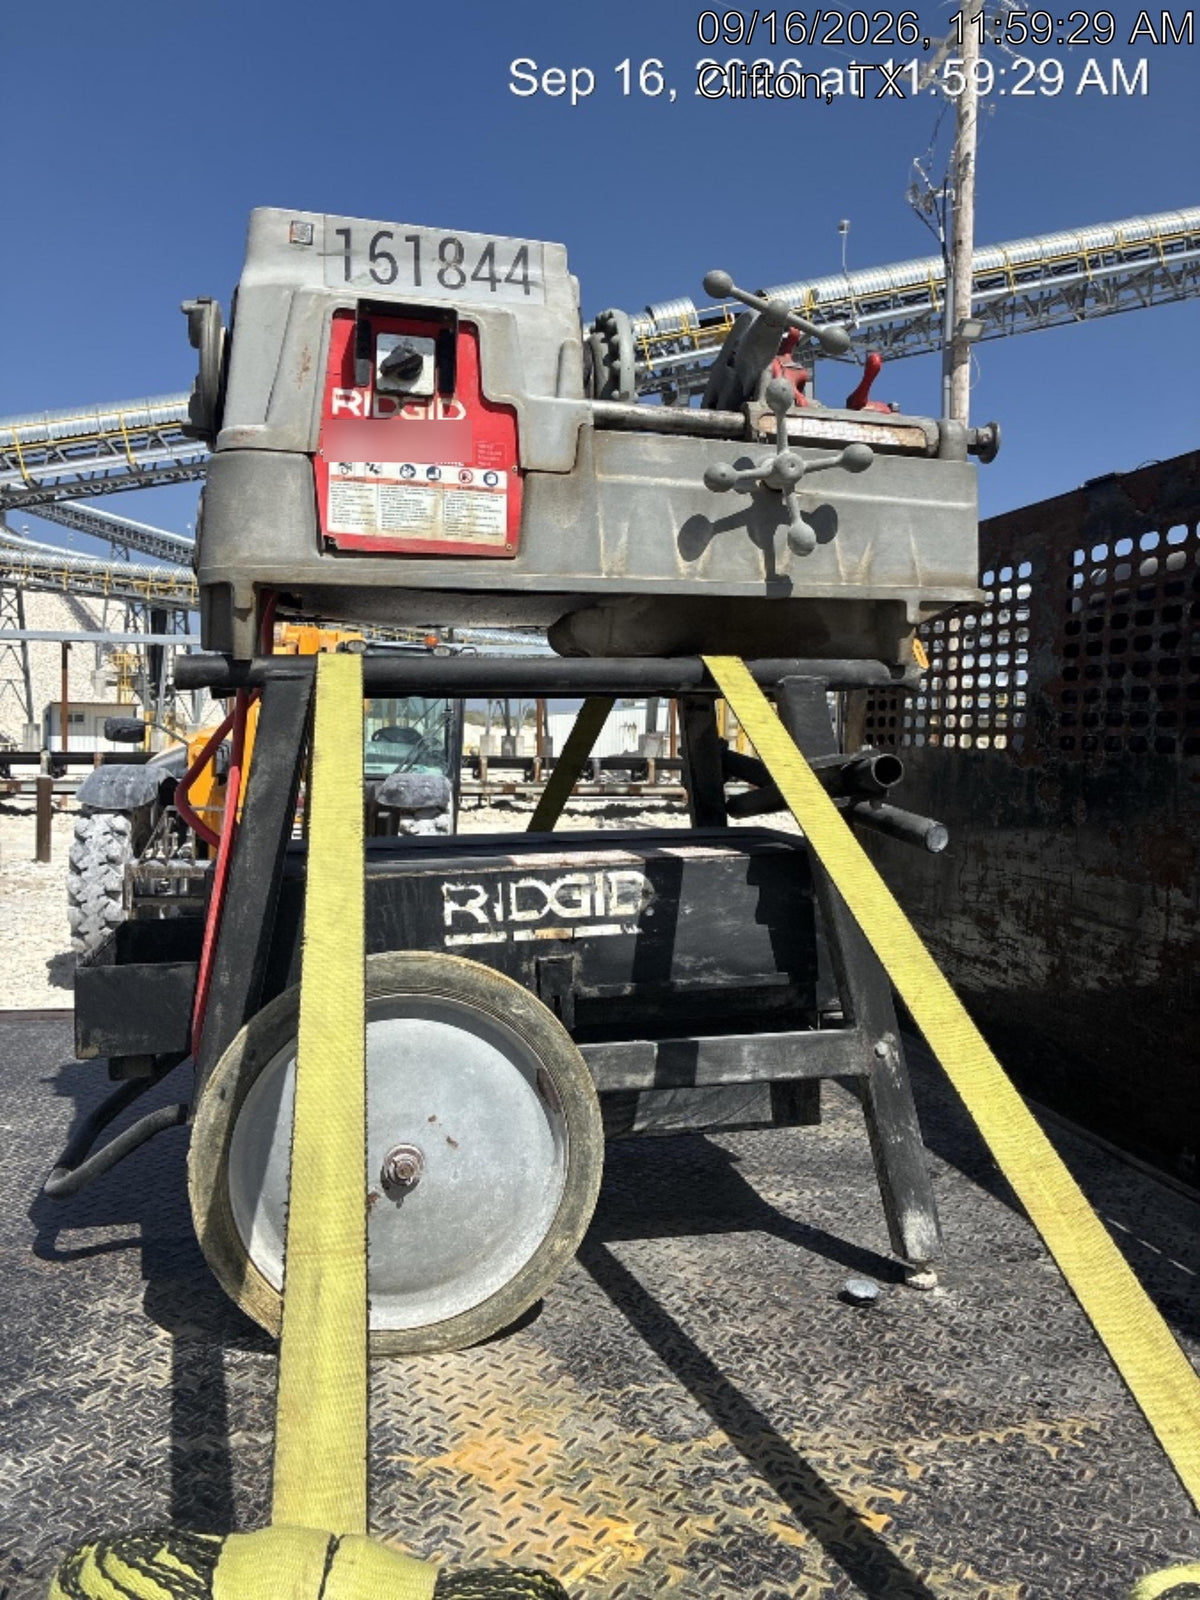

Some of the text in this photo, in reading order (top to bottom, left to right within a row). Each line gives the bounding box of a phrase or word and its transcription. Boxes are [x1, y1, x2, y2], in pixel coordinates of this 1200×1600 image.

[336, 226, 530, 296] 161844
[331, 387, 467, 421] RIDGID
[440, 868, 656, 927] RIDGID
